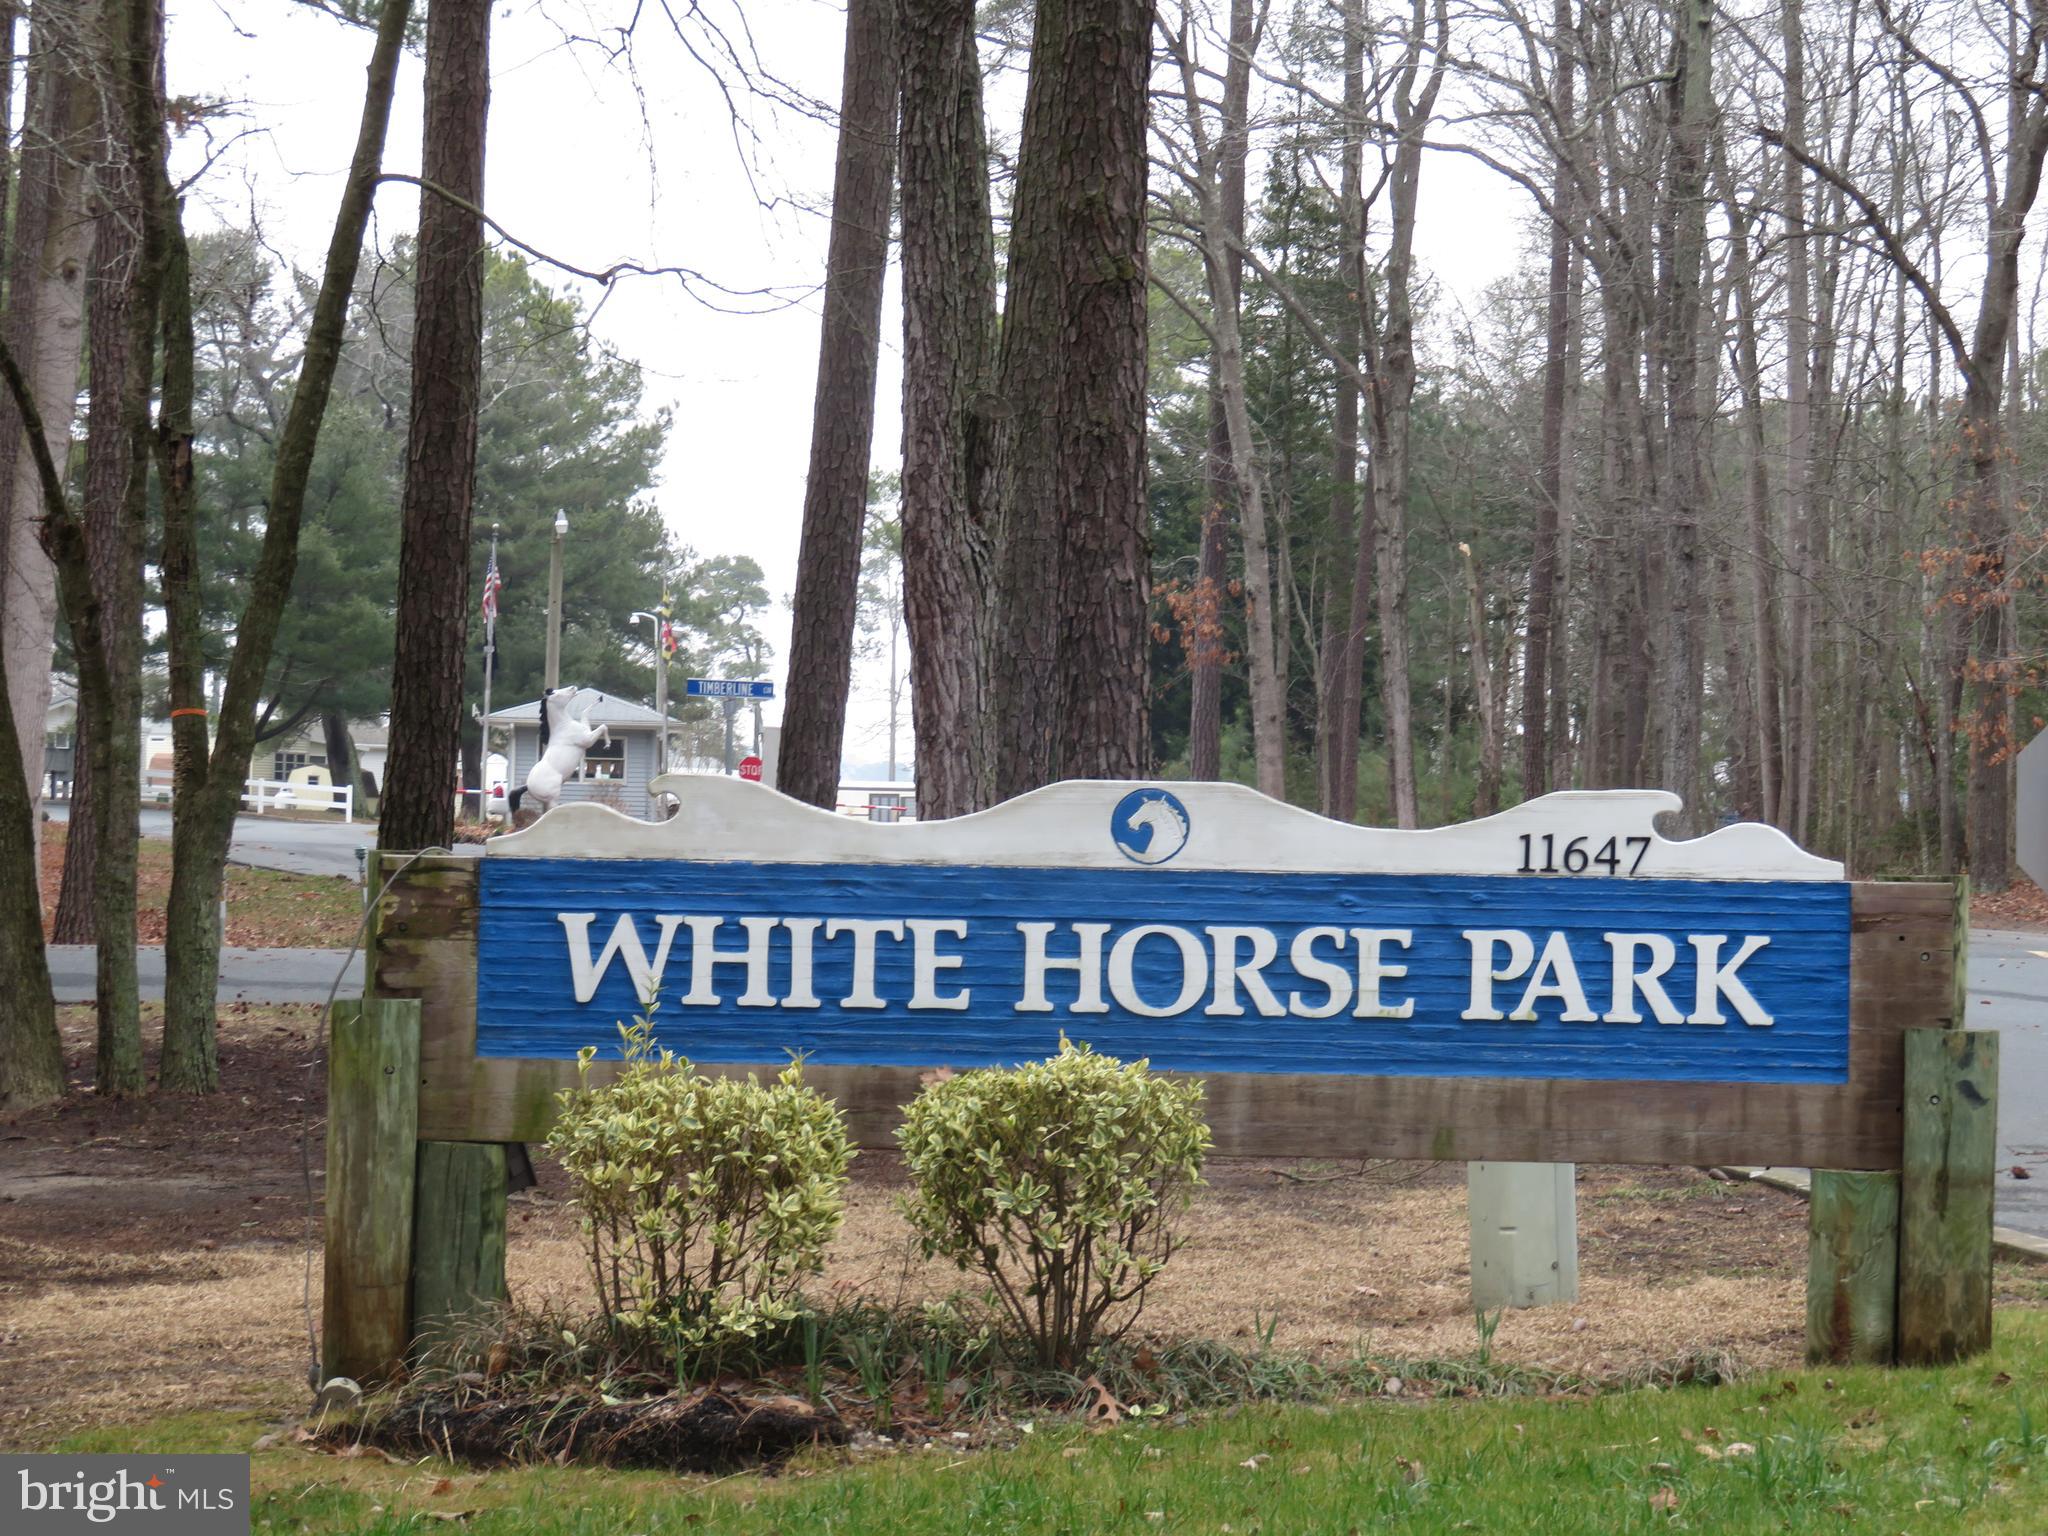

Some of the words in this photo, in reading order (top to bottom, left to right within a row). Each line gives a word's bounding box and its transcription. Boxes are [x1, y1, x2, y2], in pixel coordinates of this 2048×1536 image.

[698, 681, 754, 696] TIMBERLINE
[1517, 833, 1652, 877] 11647
[557, 913, 970, 1010] WHITE
[1014, 921, 1416, 1018] HORSE
[1461, 929, 1774, 1026] PARK
